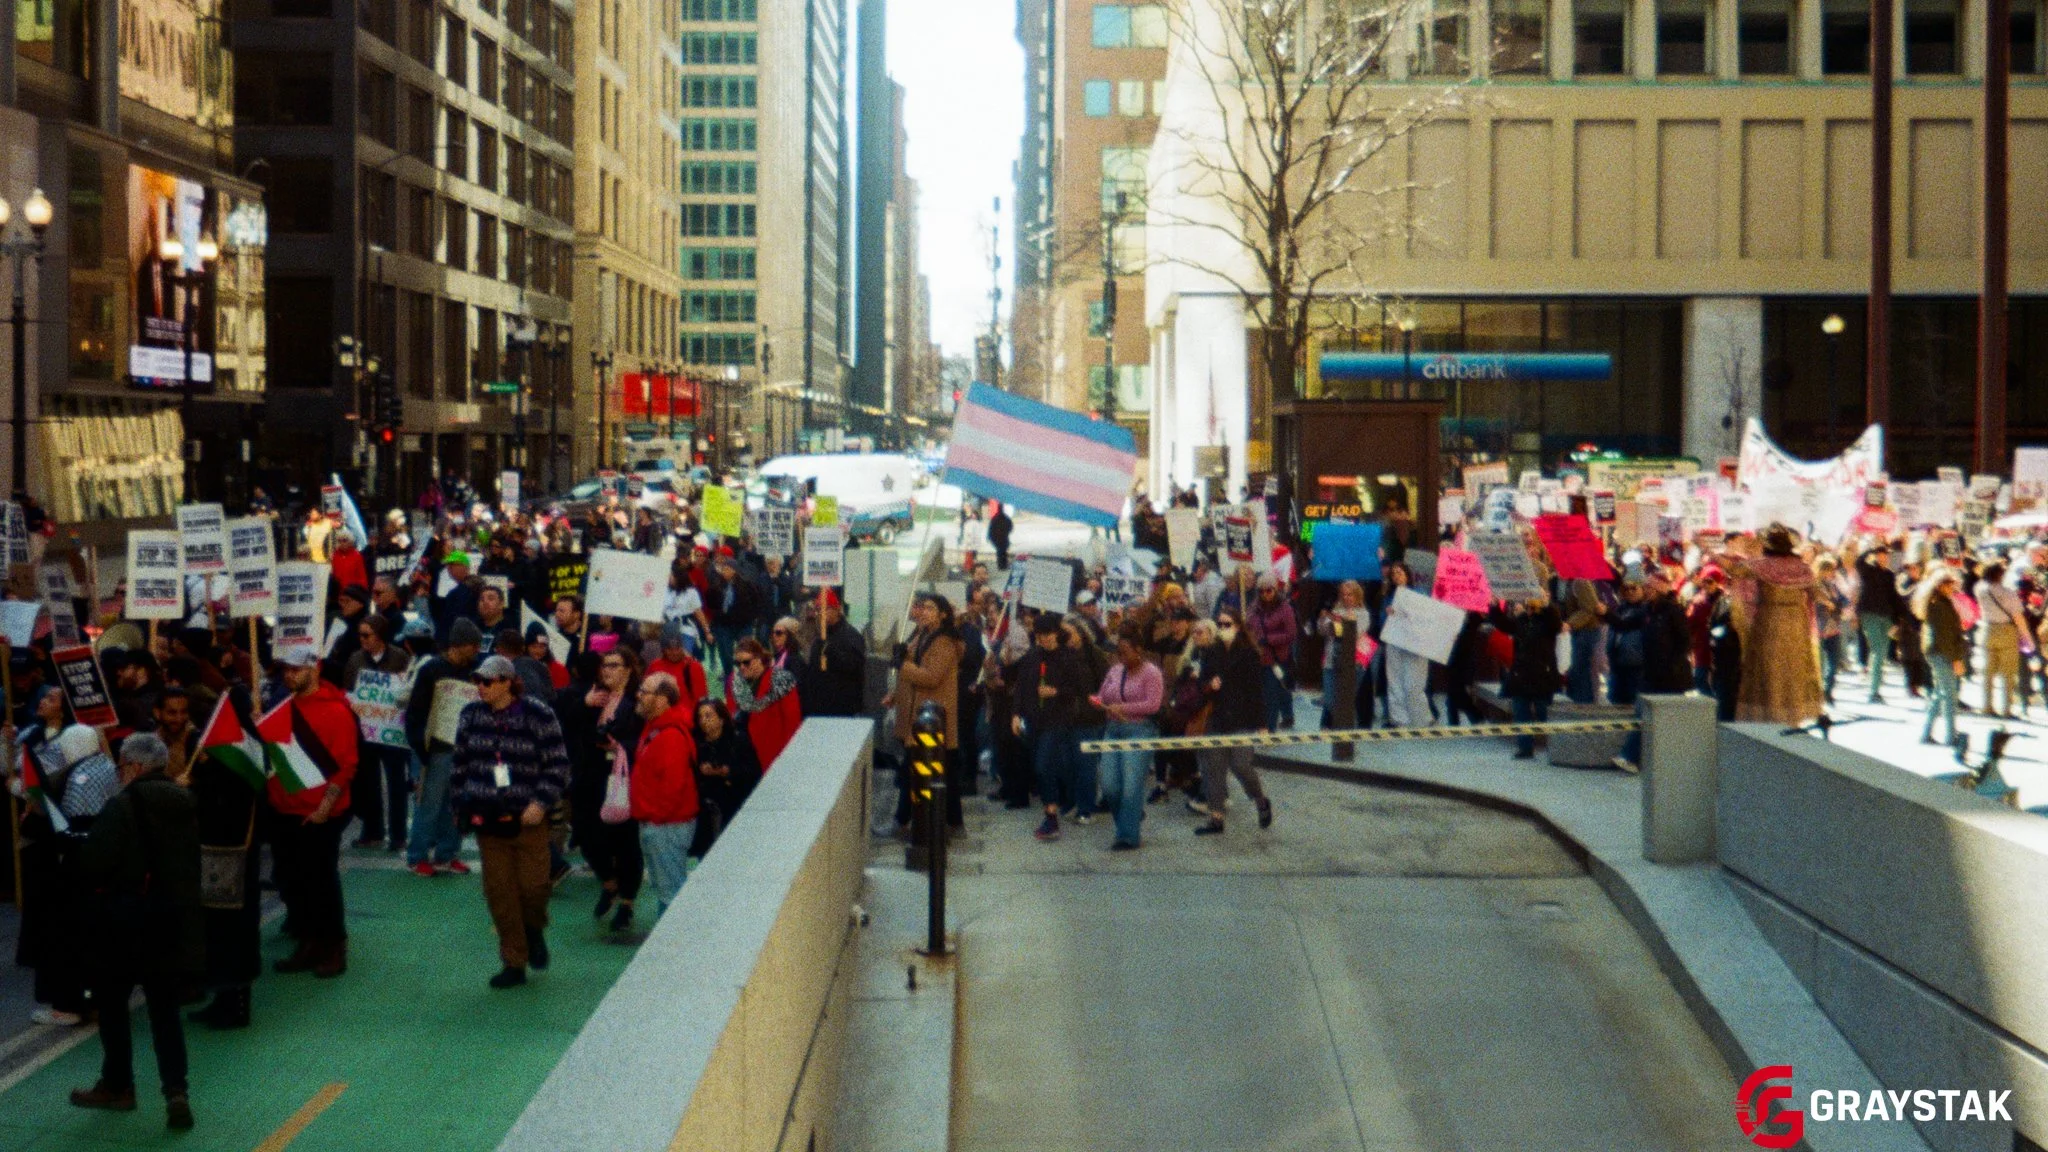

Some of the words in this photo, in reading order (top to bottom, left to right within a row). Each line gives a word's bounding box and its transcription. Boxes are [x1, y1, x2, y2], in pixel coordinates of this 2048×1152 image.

[1423, 356, 1505, 379] citibank
[1305, 504, 1328, 517] GET
[1331, 504, 1361, 517] LOUD
[61, 660, 93, 676] STOP
[68, 672, 93, 685] WAR
[359, 671, 391, 688] WAR
